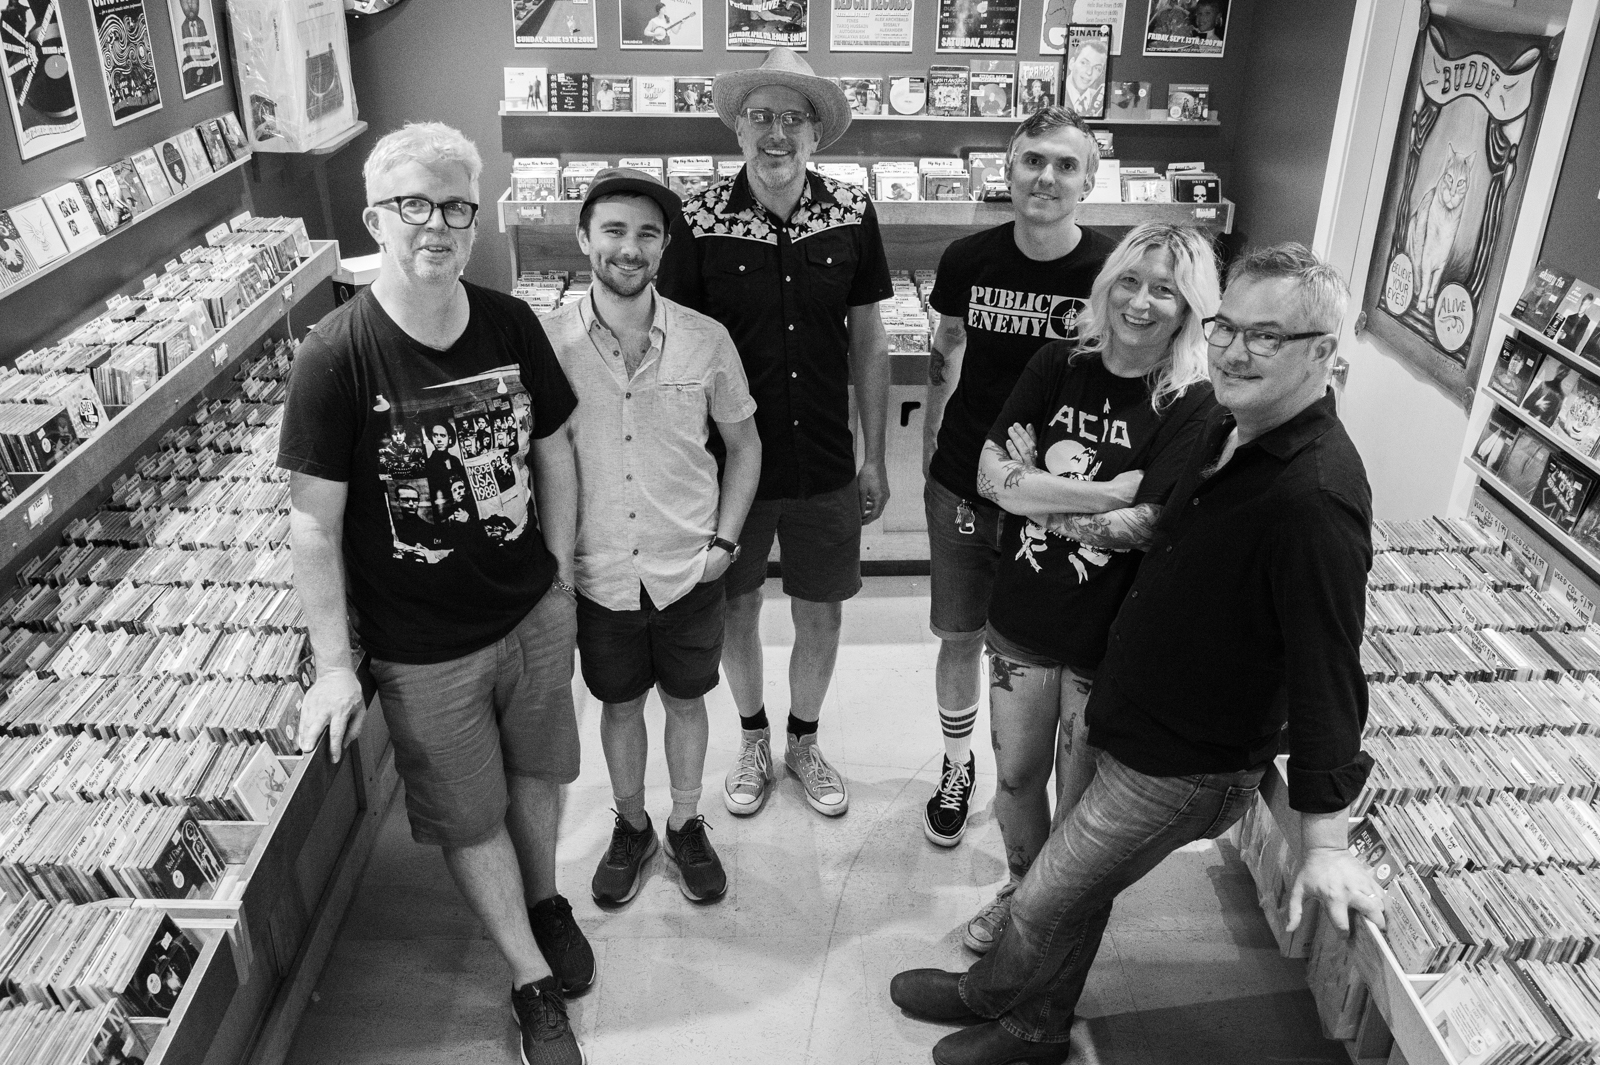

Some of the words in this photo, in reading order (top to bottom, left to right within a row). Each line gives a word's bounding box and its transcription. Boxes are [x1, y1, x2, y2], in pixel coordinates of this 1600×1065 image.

[941, 37, 980, 48] SATURDAY,
[981, 38, 1000, 48] JUNE
[1147, 32, 1169, 42] FRIDAY,
[1023, 65, 1054, 79] TRAMPS
[1441, 60, 1501, 99] BUDDY
[1391, 261, 1412, 283] BELIEVE
[1392, 276, 1409, 294] YOUR
[970, 285, 1051, 313] PUBLIC
[1386, 287, 1408, 309] EYES!
[1438, 296, 1467, 318] ALIVE
[967, 309, 1046, 338] ENEMY
[467, 464, 490, 476] MODE
[471, 474, 493, 489] USA
[474, 484, 498, 501] 1988
[1554, 570, 1567, 585] USED
[65, 739, 82, 760] GENESIS
[1360, 830, 1374, 849] REBA
[62, 944, 77, 966] BRIAN
